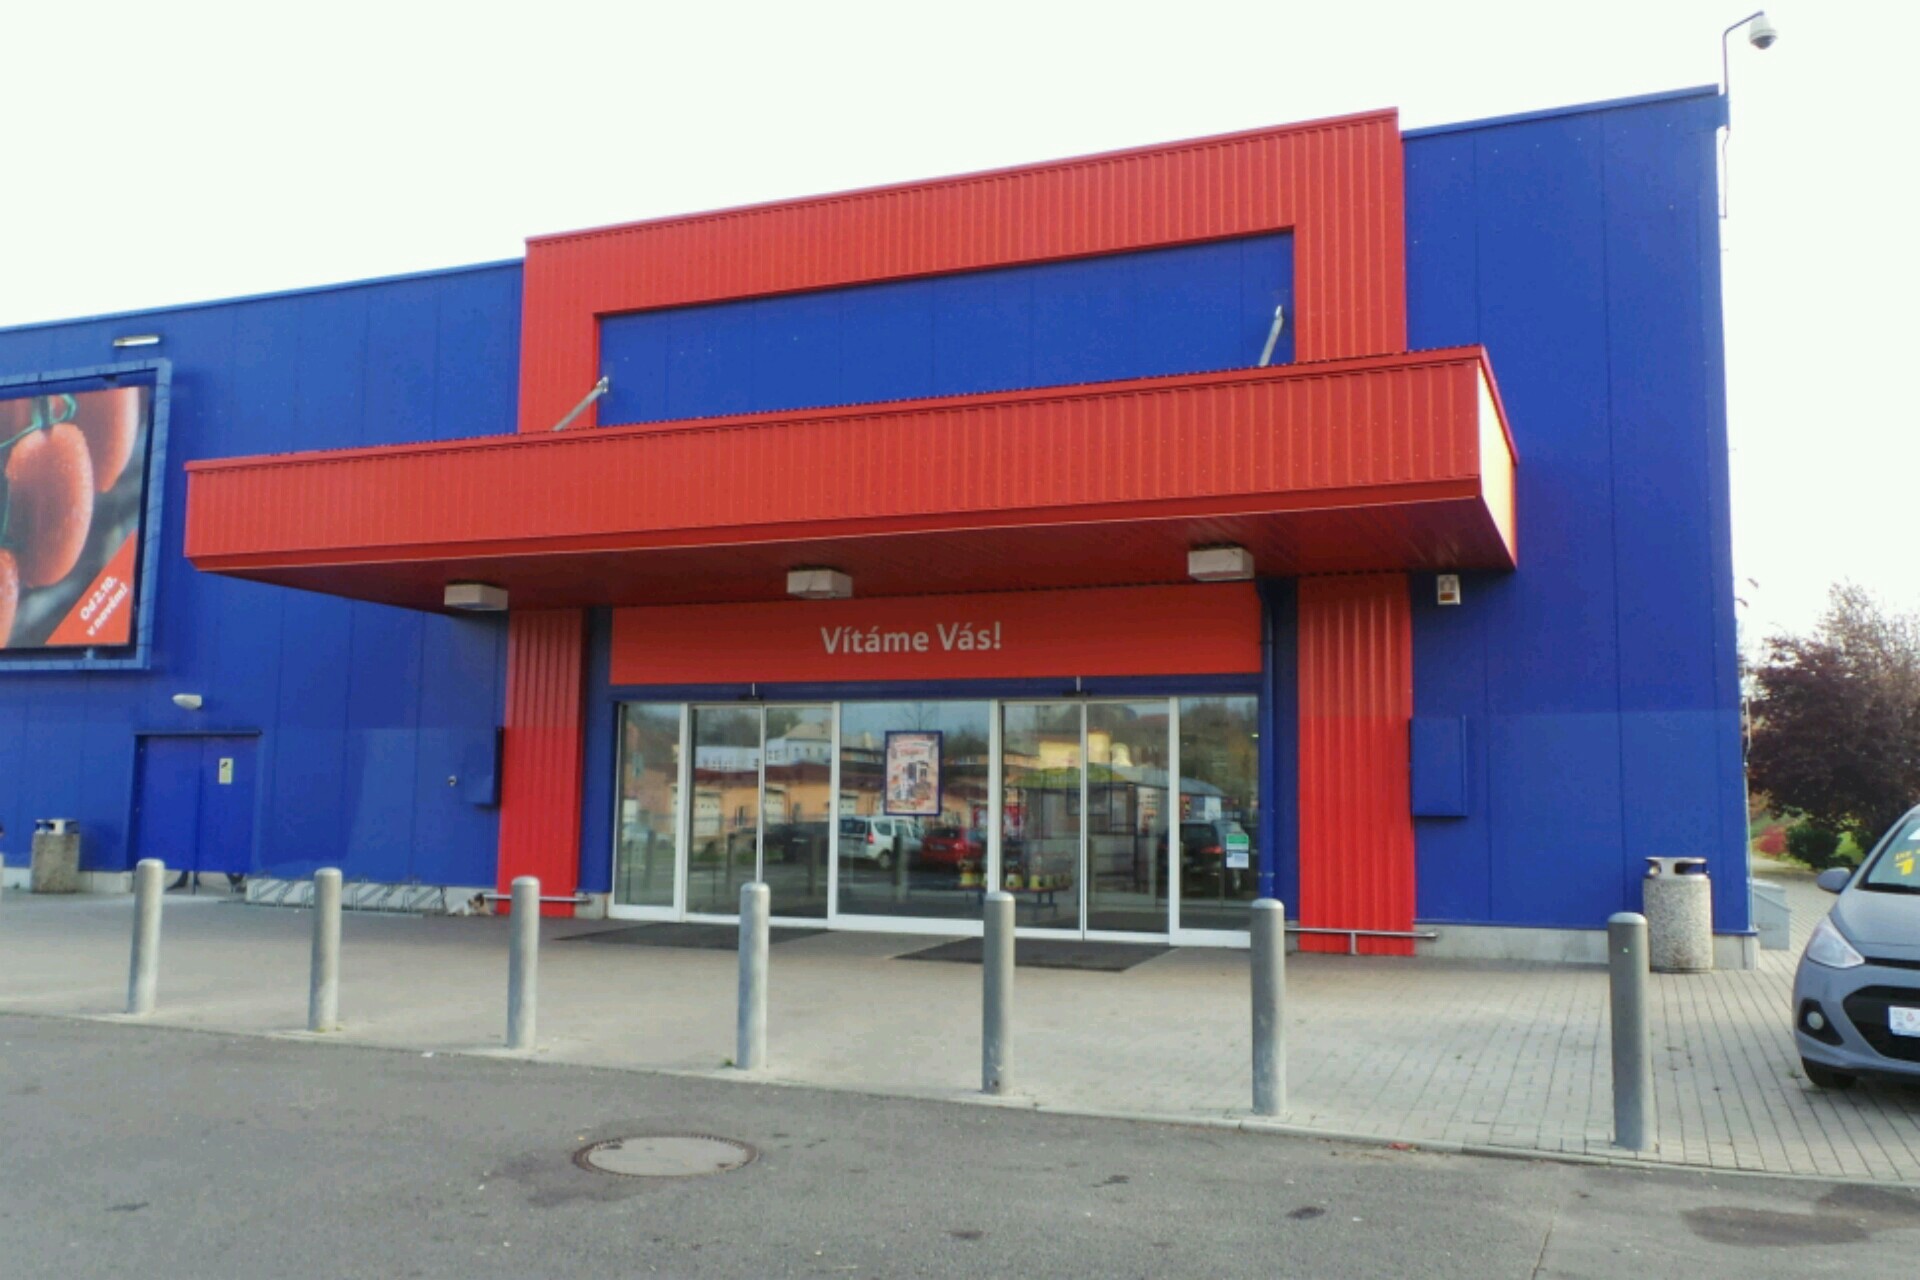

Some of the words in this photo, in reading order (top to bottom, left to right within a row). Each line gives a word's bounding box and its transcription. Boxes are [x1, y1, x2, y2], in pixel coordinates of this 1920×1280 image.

[80, 598, 98, 620] Od
[820, 625, 930, 654] Vítáme
[936, 621, 1002, 651] Vás!
